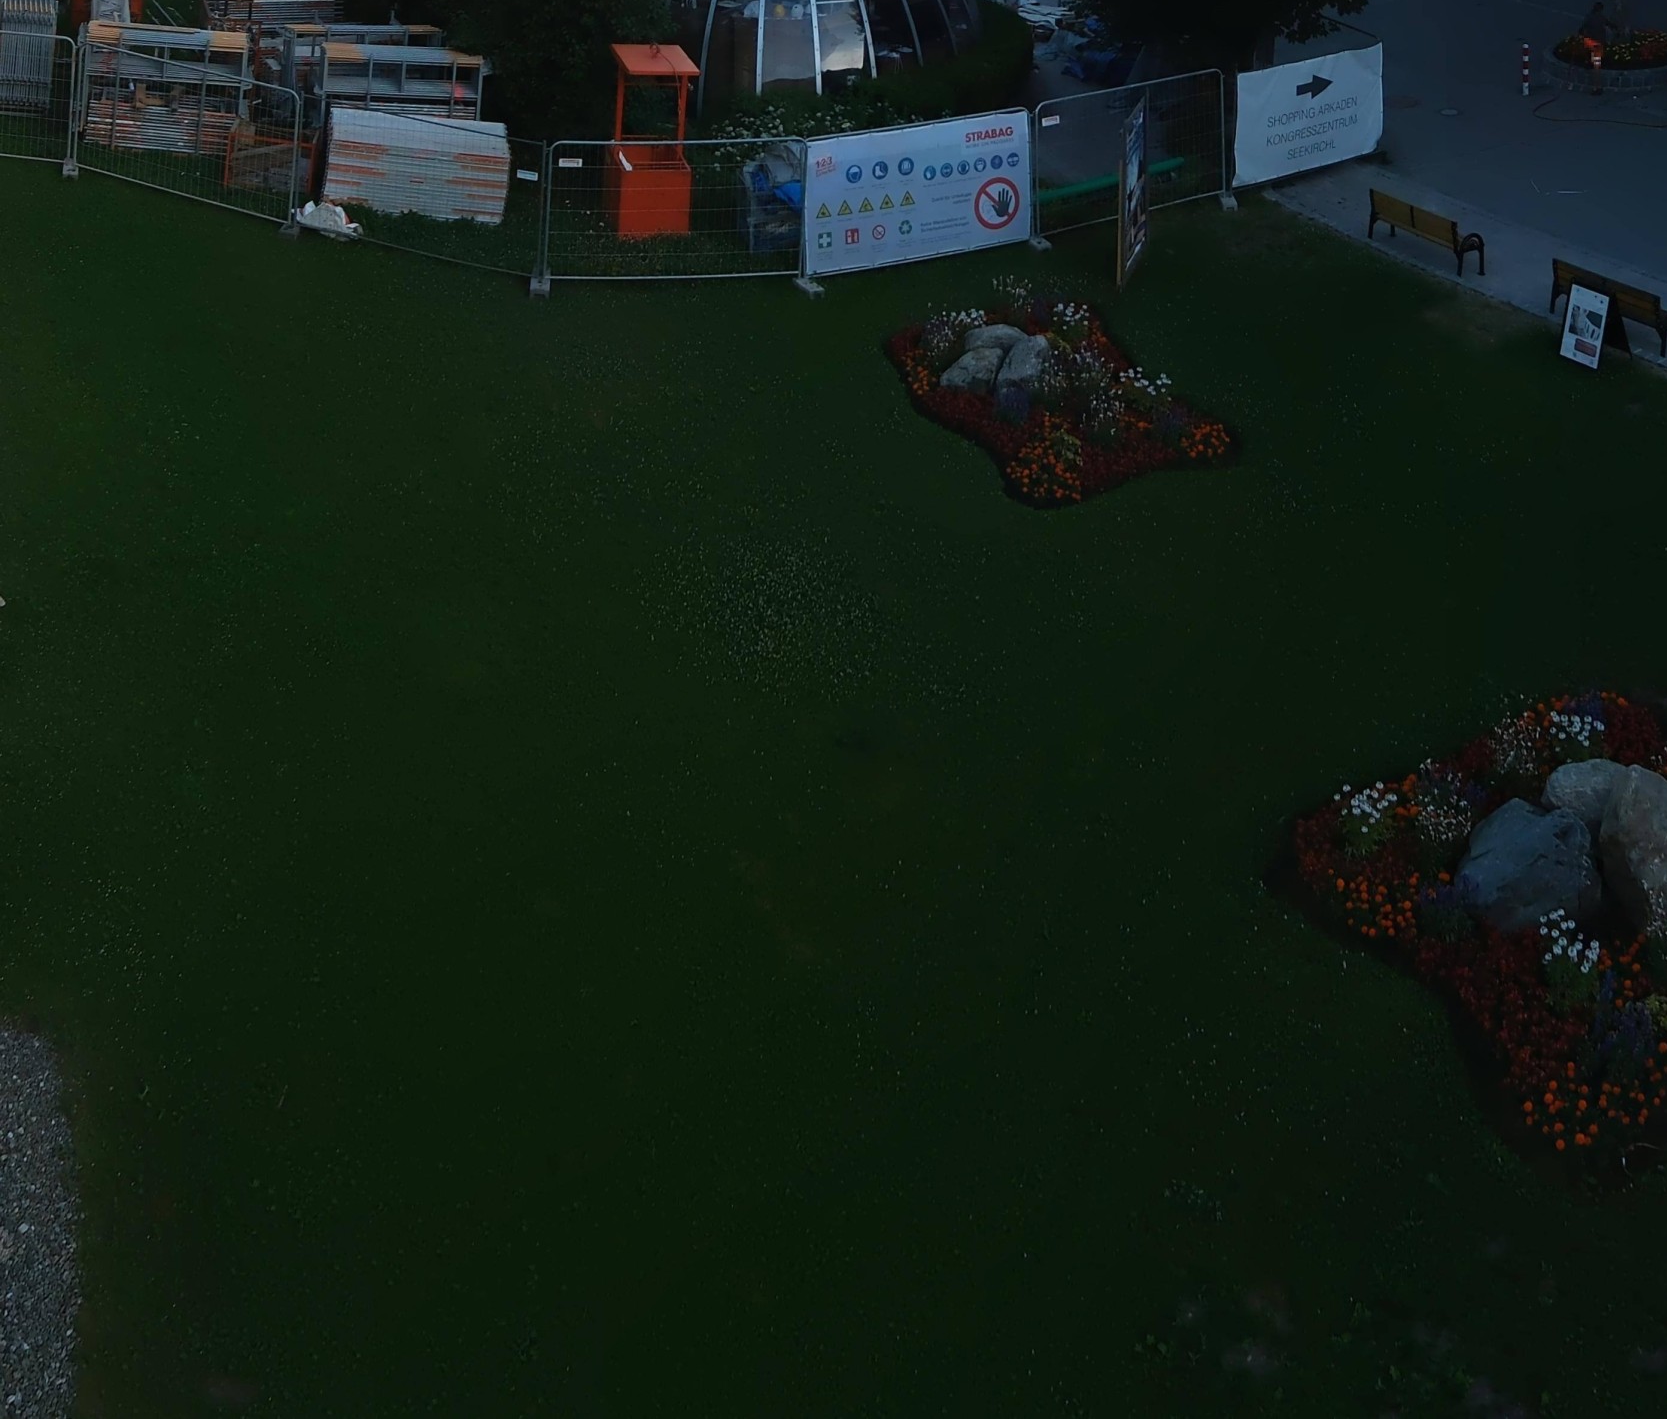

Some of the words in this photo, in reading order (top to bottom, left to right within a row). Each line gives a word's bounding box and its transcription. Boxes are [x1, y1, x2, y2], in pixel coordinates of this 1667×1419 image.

[1267, 107, 1316, 128] SHOPPING
[1318, 96, 1358, 116] ARKADEN
[965, 127, 1014, 143] STRABAG
[1266, 114, 1358, 147] KONGRESSZENTRUM
[1287, 140, 1336, 160] SEEKIRCHL
